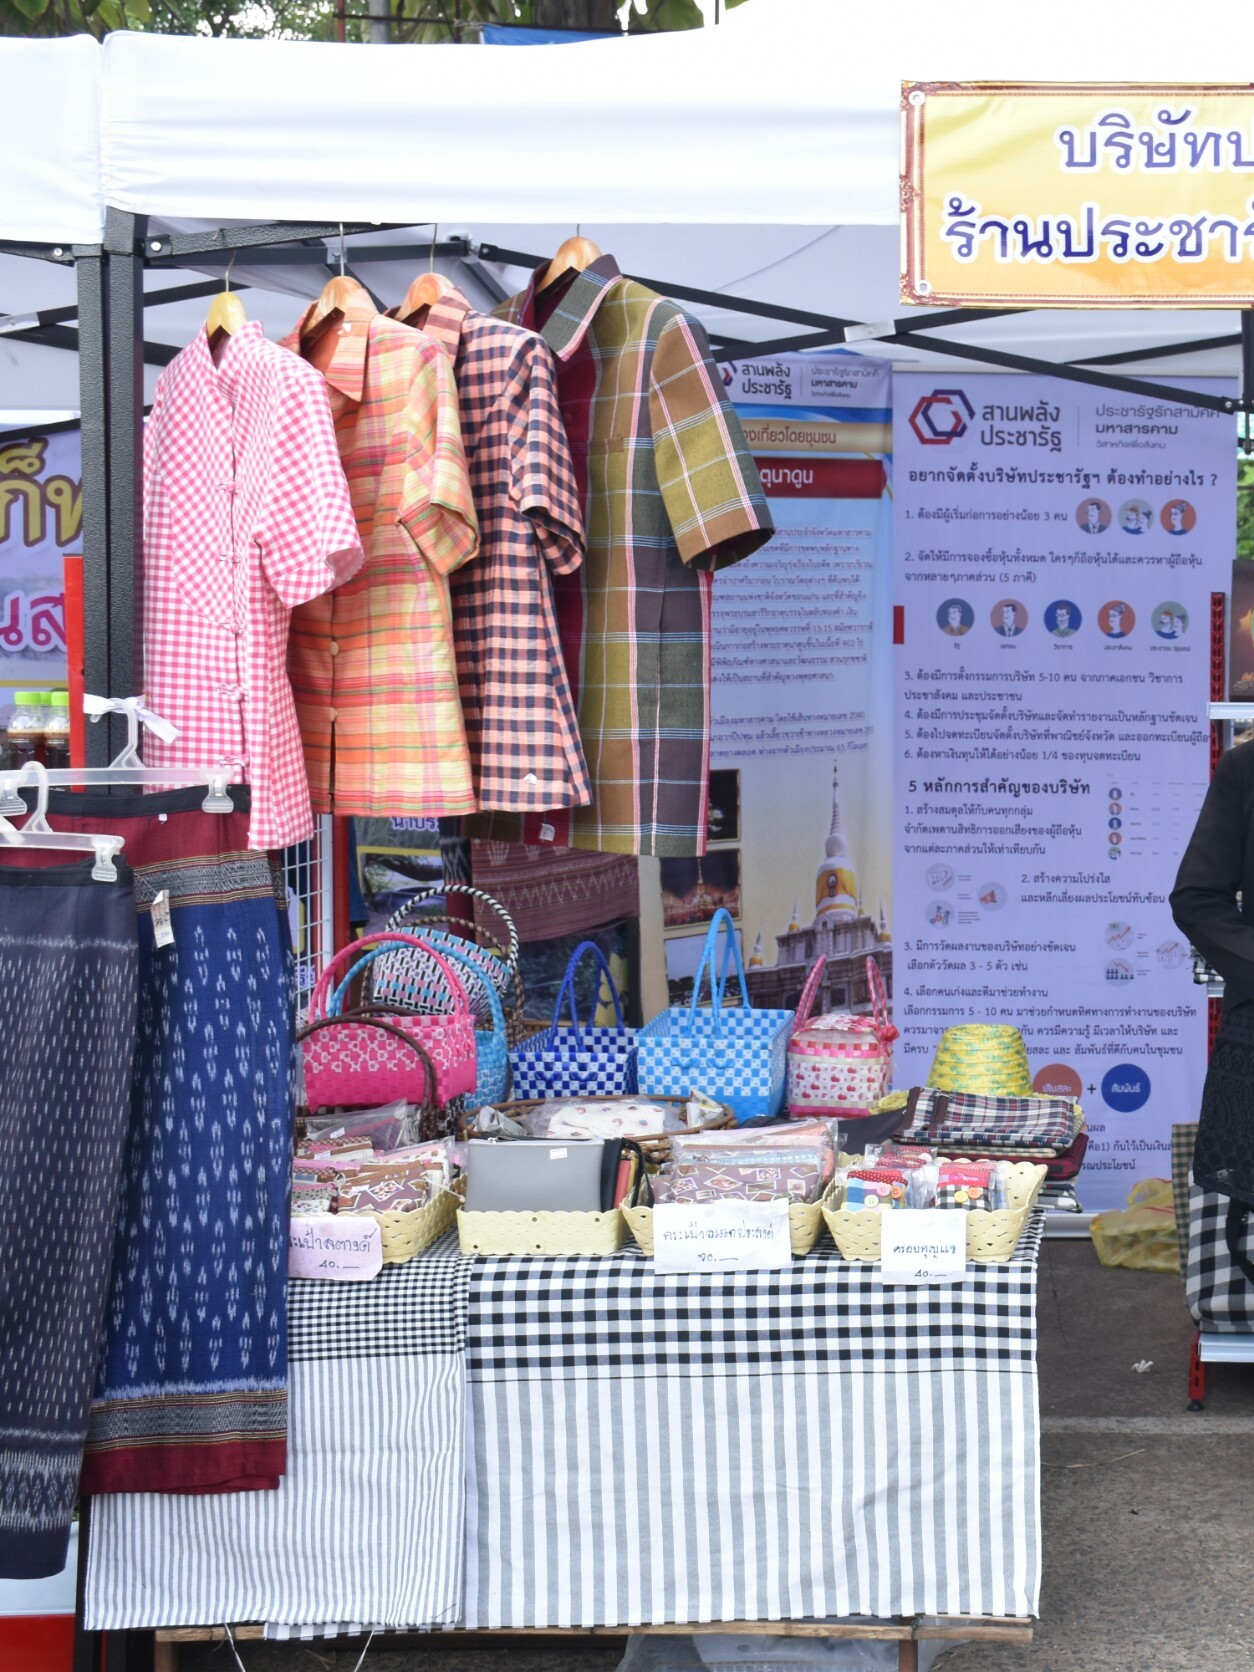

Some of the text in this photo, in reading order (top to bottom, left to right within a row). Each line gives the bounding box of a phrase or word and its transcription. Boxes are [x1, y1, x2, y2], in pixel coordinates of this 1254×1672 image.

[742, 362, 791, 378] สานพลัง
[742, 379, 792, 399] ประชารัฐ
[982, 400, 1061, 422] สานพลัง
[1095, 423, 1178, 435] มหาสารคาม
[980, 424, 1062, 452] ประชารัฐ
[909, 462, 1100, 489] อยากจัดตั้งบริษัทประชารัฐฯ
[1107, 468, 1205, 486] ต้องทำอย่างไร
[906, 510, 914, 519] 1.
[1044, 512, 1050, 521] 3
[1054, 512, 1068, 521] คน
[905, 552, 914, 561] 2.
[905, 672, 913, 681] 3.
[1063, 674, 1077, 683] คน
[904, 711, 913, 720] 4.
[904, 730, 913, 739] 5.
[904, 749, 913, 758] 6.
[909, 776, 1091, 797] 5 หลักการสำคัญของบริษัท
[905, 806, 913, 815] 1.
[1021, 874, 1030, 883] 2.
[904, 942, 912, 951] 3.
[970, 962, 976, 971] 3
[987, 962, 992, 971] 5
[904, 987, 913, 997] 4.
[968, 1007, 974, 1016] 5
[985, 1007, 996, 1016] 10
[1000, 1008, 1013, 1016] คน
[1161, 1027, 1178, 1036] และ
